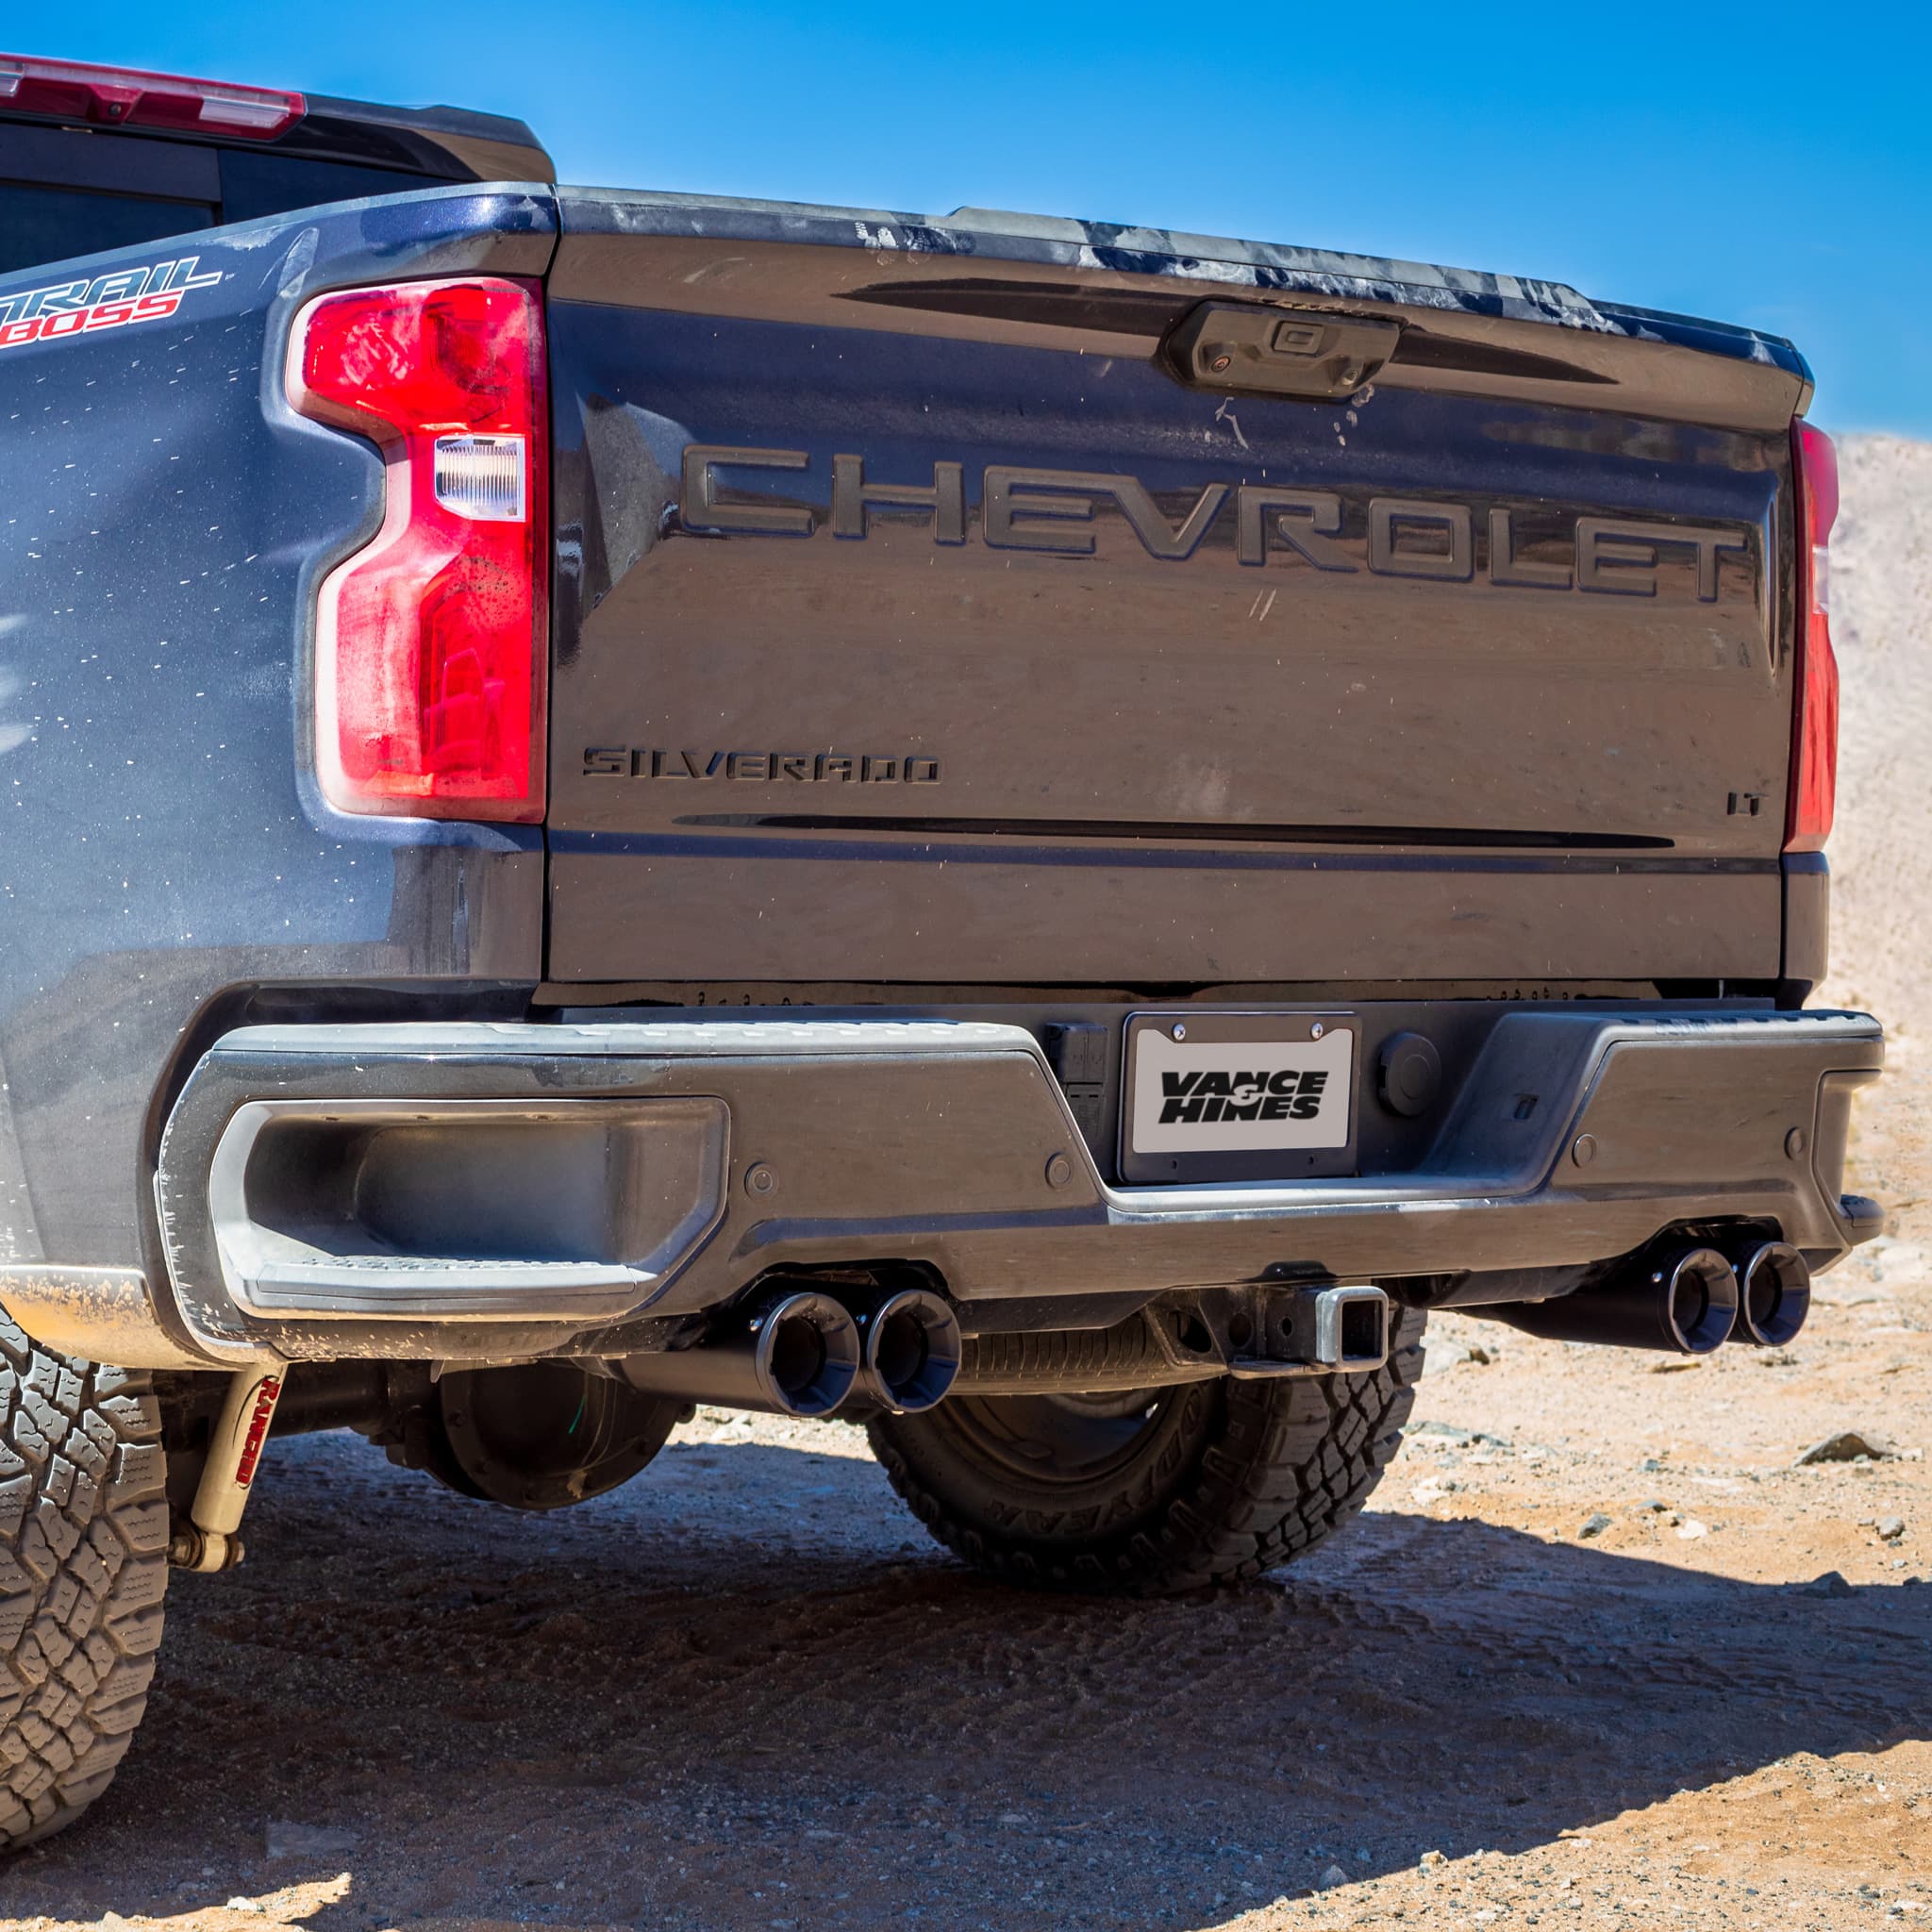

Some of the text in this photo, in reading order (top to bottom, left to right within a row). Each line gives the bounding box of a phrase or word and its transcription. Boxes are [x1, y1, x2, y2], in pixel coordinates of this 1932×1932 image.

[0, 256, 224, 323] TRAIL
[0, 289, 185, 348] BOSS
[681, 443, 1748, 603] CHEVROLET
[582, 746, 943, 785] SILVERADO
[1726, 791, 1770, 817] LT
[1161, 1070, 1329, 1098] VANCE
[1158, 1095, 1322, 1124] HINES
